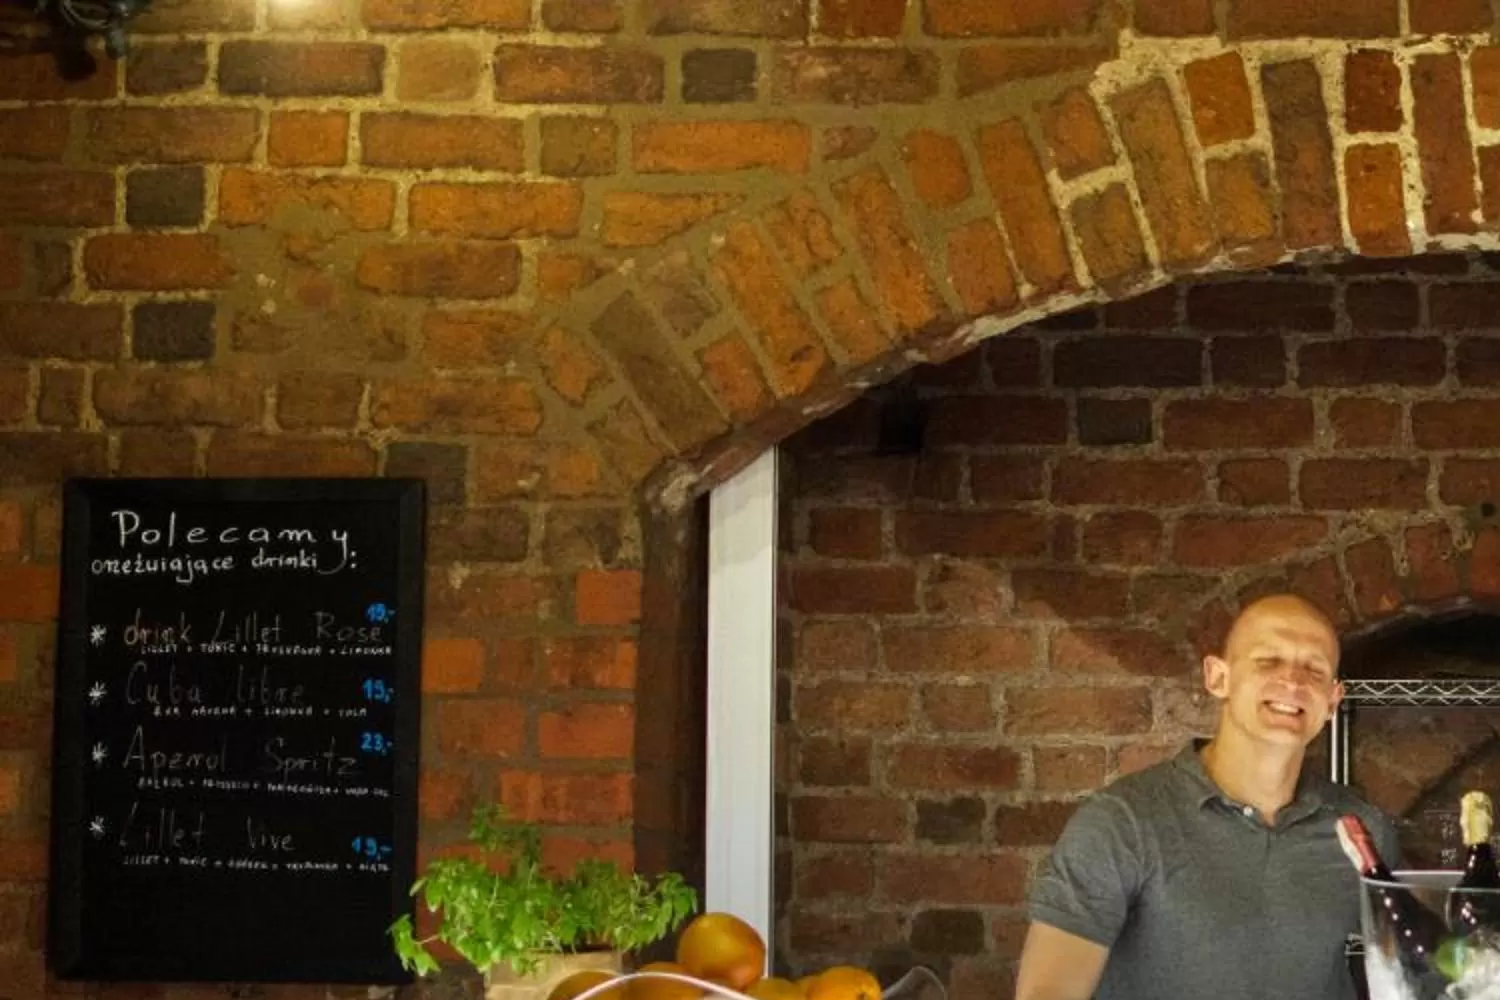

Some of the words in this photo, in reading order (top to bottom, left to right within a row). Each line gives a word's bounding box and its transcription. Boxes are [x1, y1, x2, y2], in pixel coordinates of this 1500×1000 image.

[110, 508, 349, 576] Polecamy
[122, 606, 192, 647] drink
[124, 659, 203, 706] Cuba
